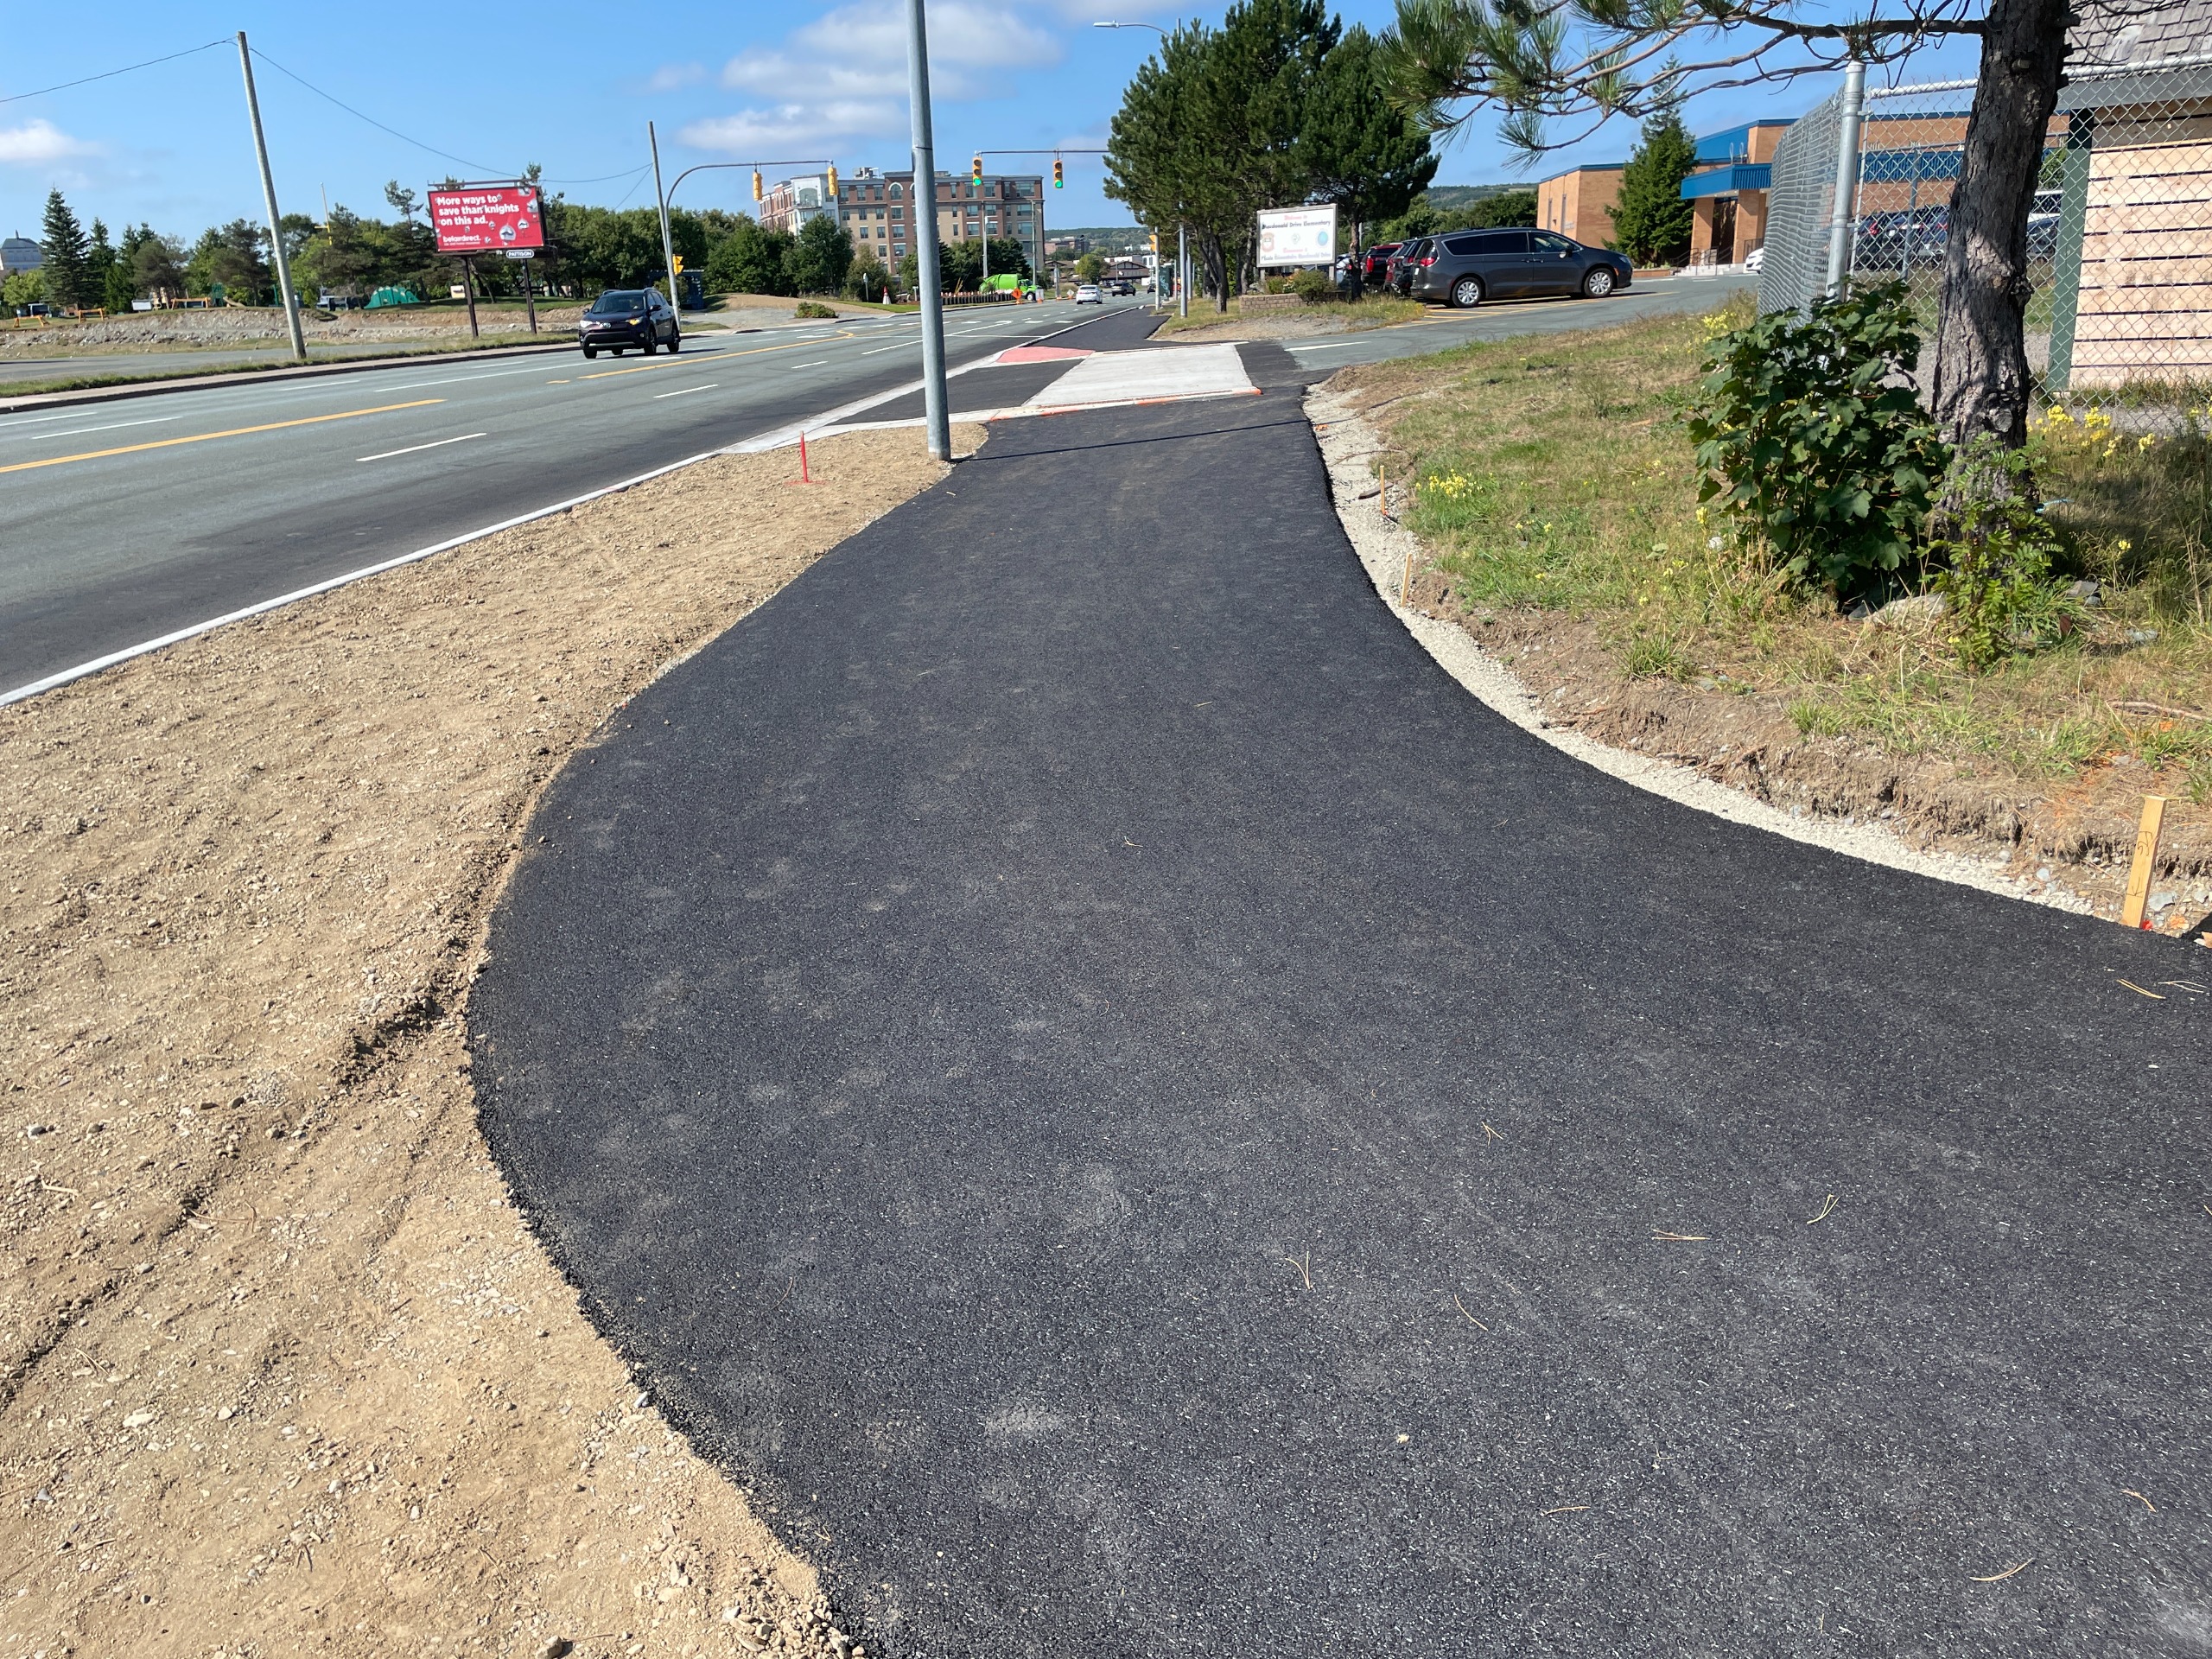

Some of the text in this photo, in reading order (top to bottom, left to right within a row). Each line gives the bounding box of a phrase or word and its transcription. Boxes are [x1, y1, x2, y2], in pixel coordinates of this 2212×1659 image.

[437, 194, 498, 206] More ways to
[438, 203, 519, 216] save than knights
[441, 215, 488, 226] on this ad.
